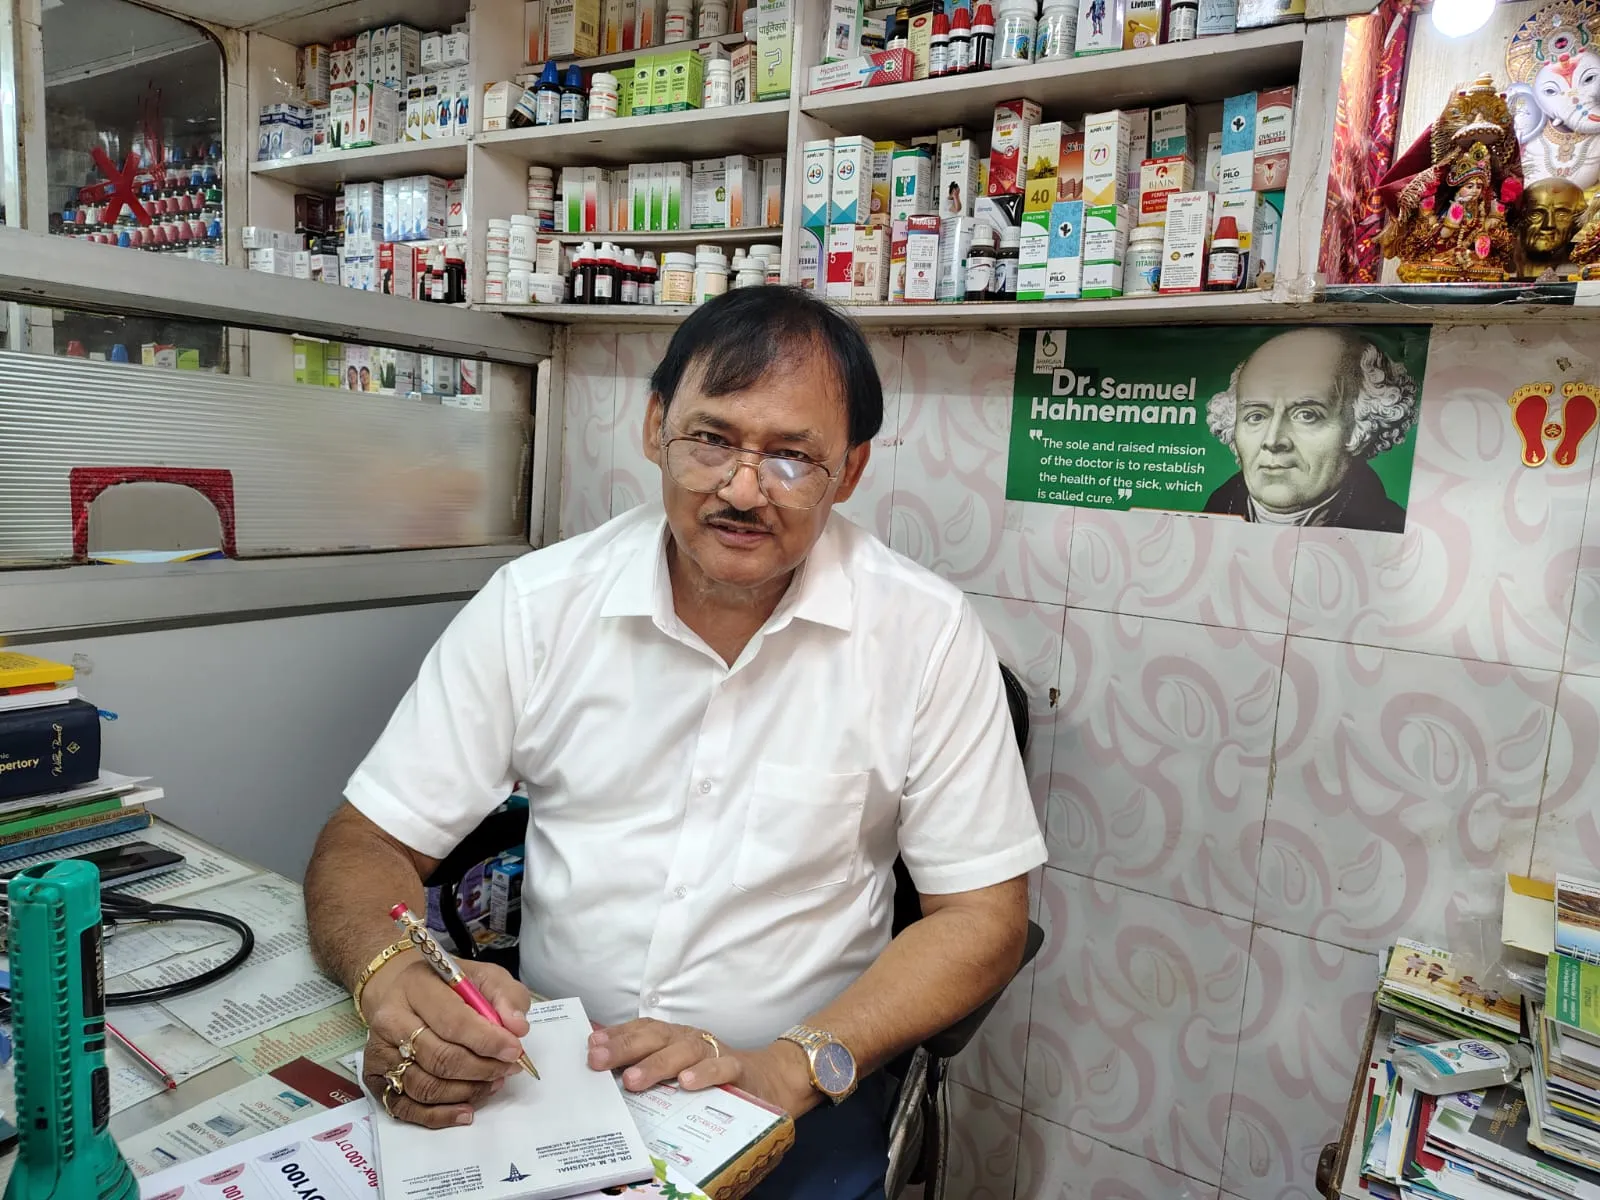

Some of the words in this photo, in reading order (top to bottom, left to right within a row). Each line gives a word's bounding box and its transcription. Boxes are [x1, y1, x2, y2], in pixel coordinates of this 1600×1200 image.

[1155, 139, 1169, 152] 84
[1094, 148, 1106, 160] 71
[809, 168, 822, 178] 49
[840, 165, 852, 174] 49
[1223, 170, 1240, 179] PILO
[1031, 190, 1050, 204] 40
[1052, 368, 1096, 396] Dr.
[1100, 377, 1197, 400] Samuel
[1031, 397, 1196, 425] Hahnemann
[1066, 440, 1090, 450] sole
[1092, 441, 1114, 452] and
[1117, 442, 1154, 454] raised
[1157, 444, 1206, 456] mission
[1040, 455, 1052, 465] of
[1054, 456, 1072, 466] the
[1075, 456, 1114, 468] doctor
[1116, 458, 1125, 470] is
[1128, 460, 1140, 470] to
[1143, 461, 1205, 474] restablish
[1039, 472, 1058, 482] the
[1060, 473, 1096, 486] health
[1098, 474, 1111, 486] of
[1113, 476, 1132, 488] the
[1135, 478, 1162, 490] sick,
[1165, 480, 1203, 492] which
[1037, 488, 1046, 499] is
[1048, 490, 1084, 502] called
[556, 1162, 596, 1173] KAUSHAL
[281, 1163, 310, 1188] 100
